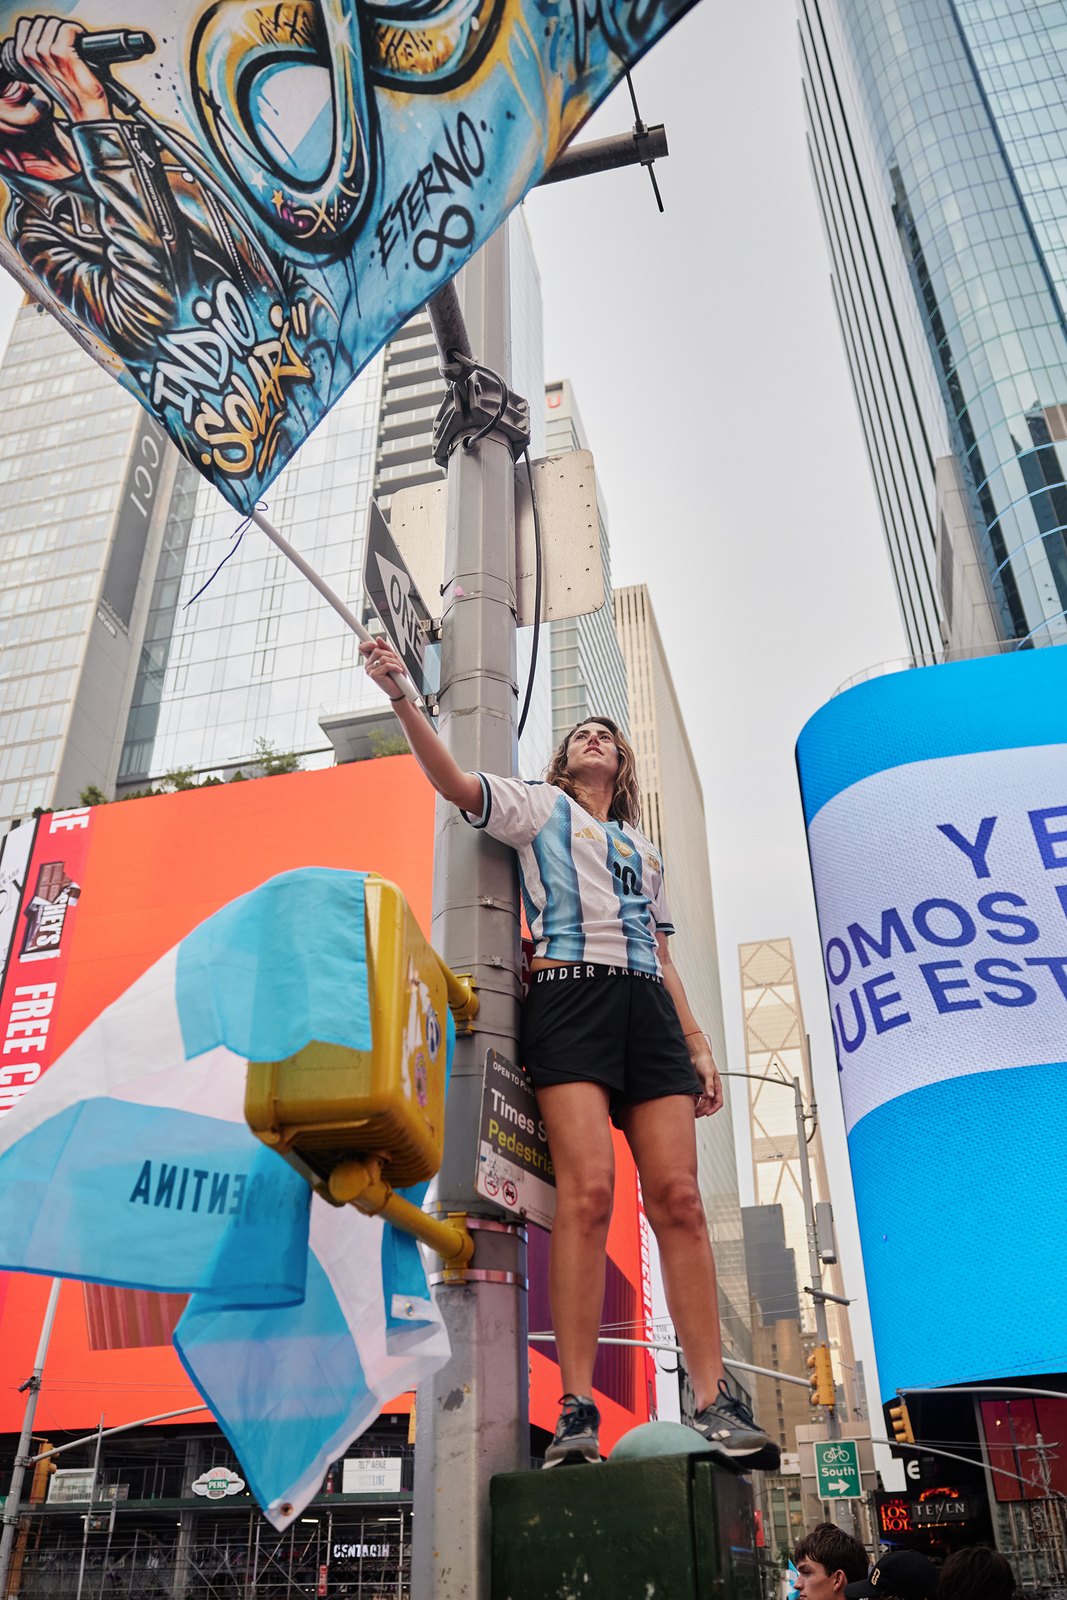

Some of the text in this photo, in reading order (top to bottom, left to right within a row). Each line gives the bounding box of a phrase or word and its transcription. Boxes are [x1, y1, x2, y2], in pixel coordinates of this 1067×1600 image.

[376, 111, 485, 270] ETERNO
[153, 280, 256, 424] INDIO
[202, 304, 312, 474] SOLARI
[390, 574, 422, 664] ONE
[936, 816, 997, 879] Y
[613, 861, 643, 896] 10
[537, 964, 595, 983] UNDER
[3, 981, 57, 1054] FREE
[835, 971, 912, 1071] UE
[493, 1062, 510, 1080] OPEN
[511, 1074, 519, 1085] TO
[491, 1088, 535, 1135] Times
[488, 1119, 556, 1176] Pedestria
[208, 1481, 228, 1489] PERK
[821, 1466, 856, 1478] South
